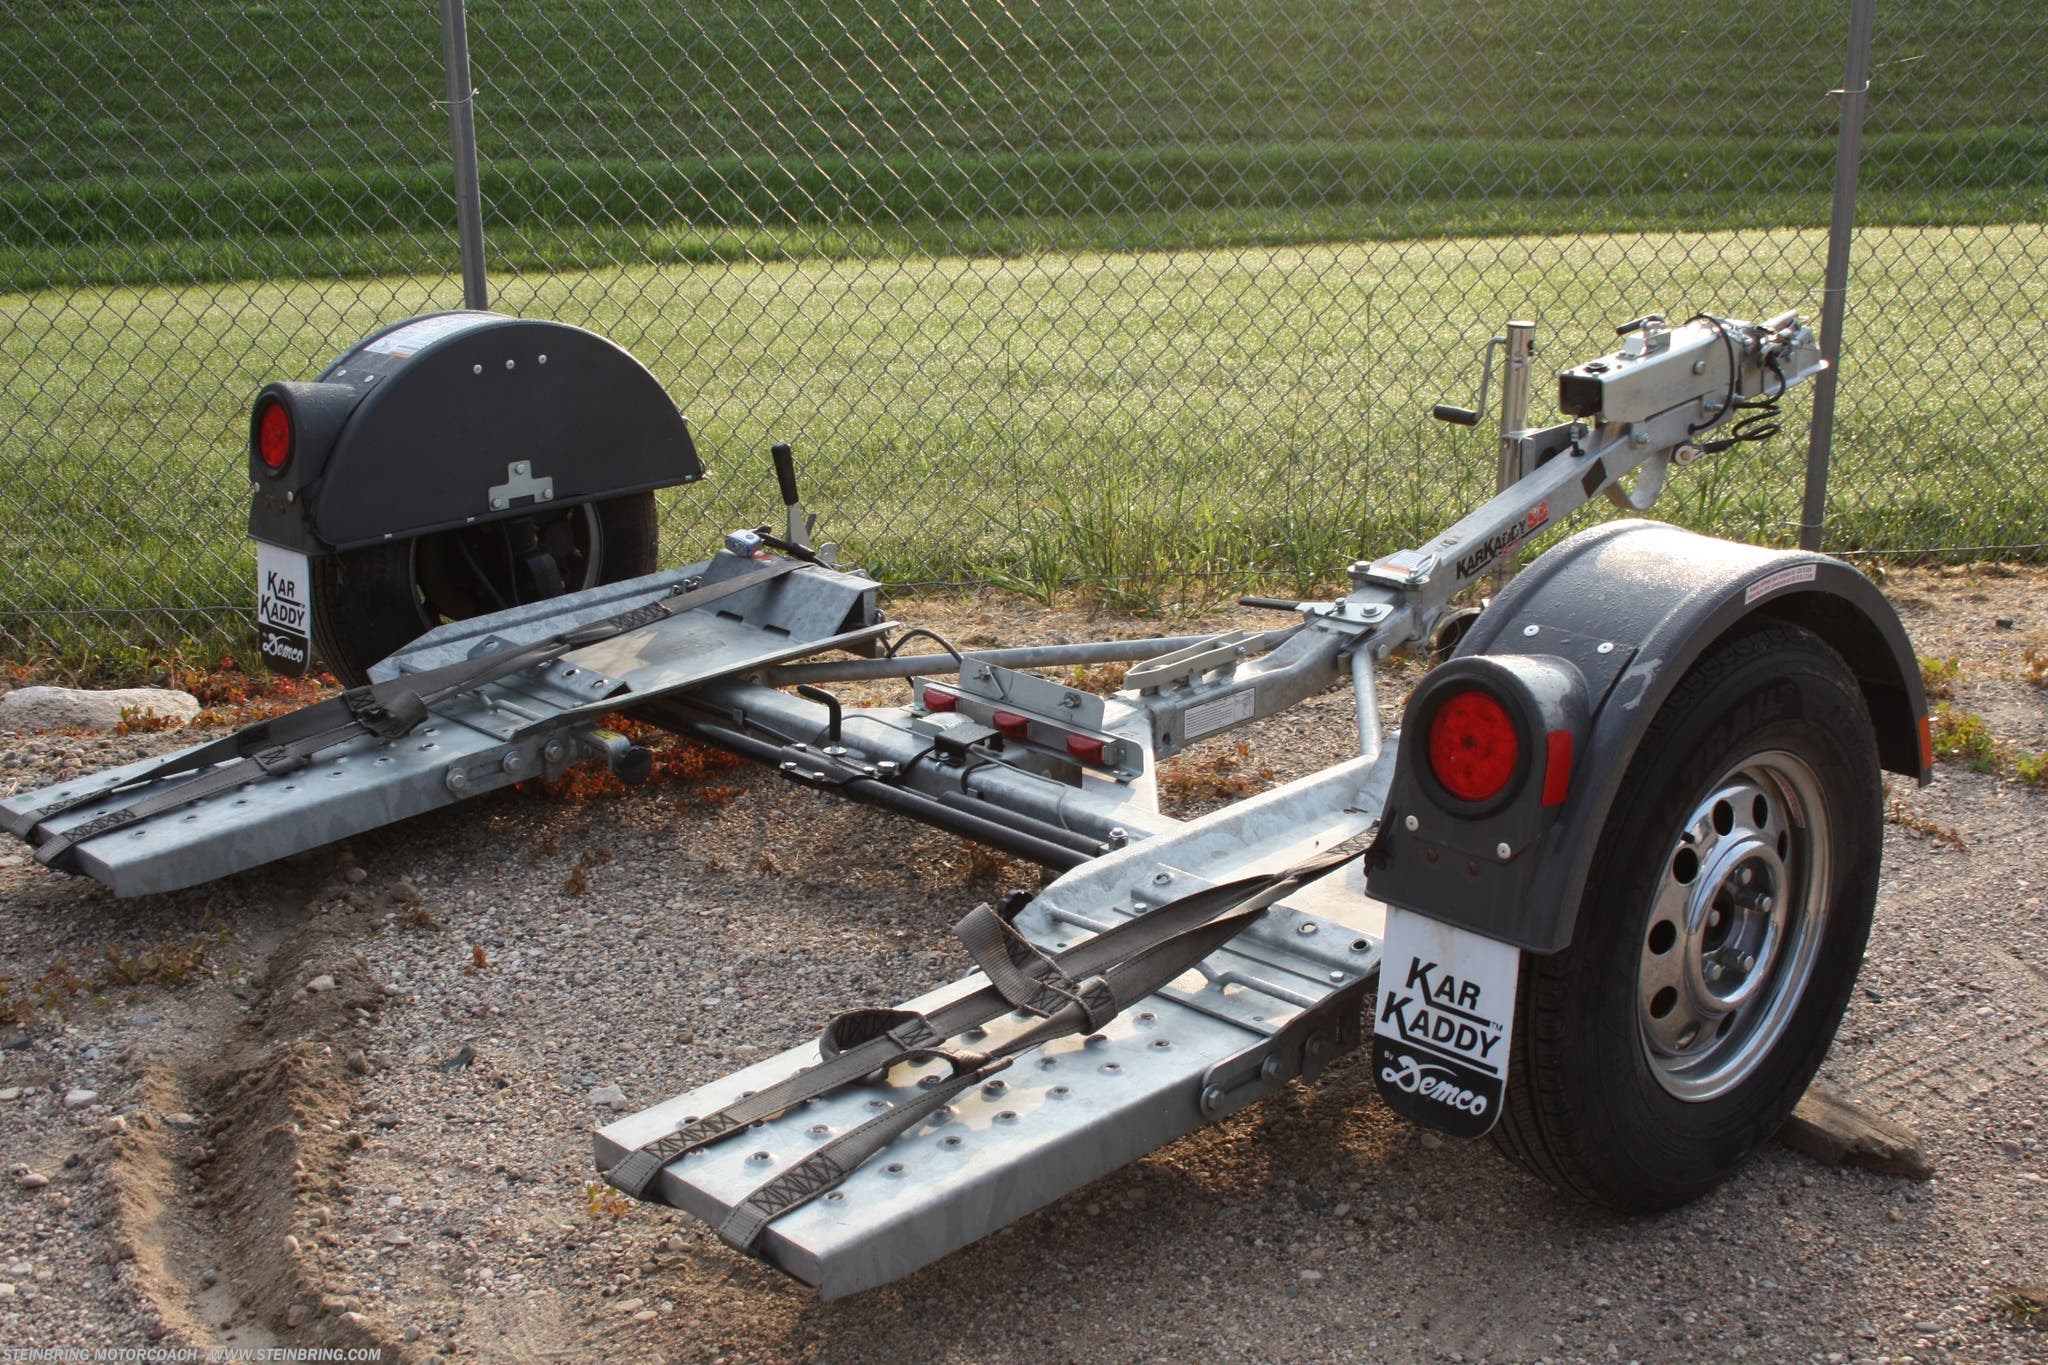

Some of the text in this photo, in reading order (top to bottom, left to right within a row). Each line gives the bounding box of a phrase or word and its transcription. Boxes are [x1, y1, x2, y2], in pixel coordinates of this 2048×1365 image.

[267, 570, 296, 599] KAR
[260, 594, 306, 627] KADDY
[262, 632, 304, 663] Demco
[1405, 956, 1482, 1012] KAR
[1381, 991, 1502, 1059] KADDY
[1382, 1055, 1488, 1116] Demco
